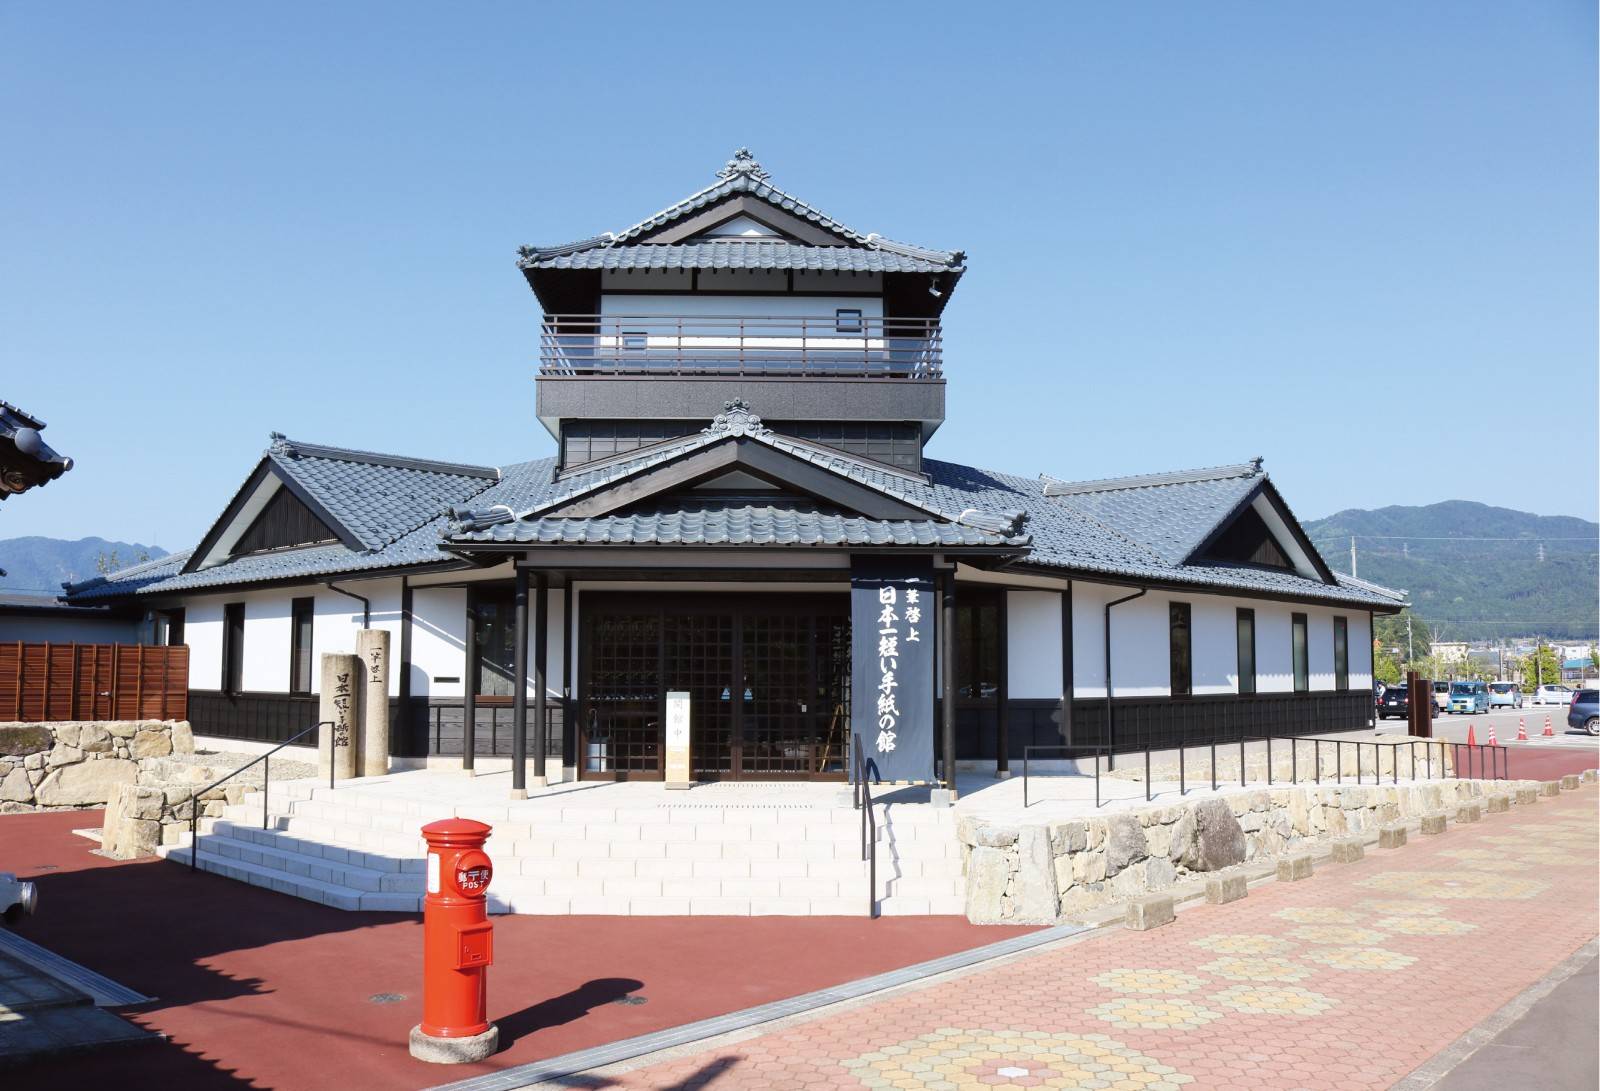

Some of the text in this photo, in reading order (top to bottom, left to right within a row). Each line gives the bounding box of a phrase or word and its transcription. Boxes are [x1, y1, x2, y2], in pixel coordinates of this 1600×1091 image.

[905, 577, 921, 642] 一筆啓上
[875, 586, 899, 752] 日本一短い手紙の館
[462, 881, 483, 890] POST
